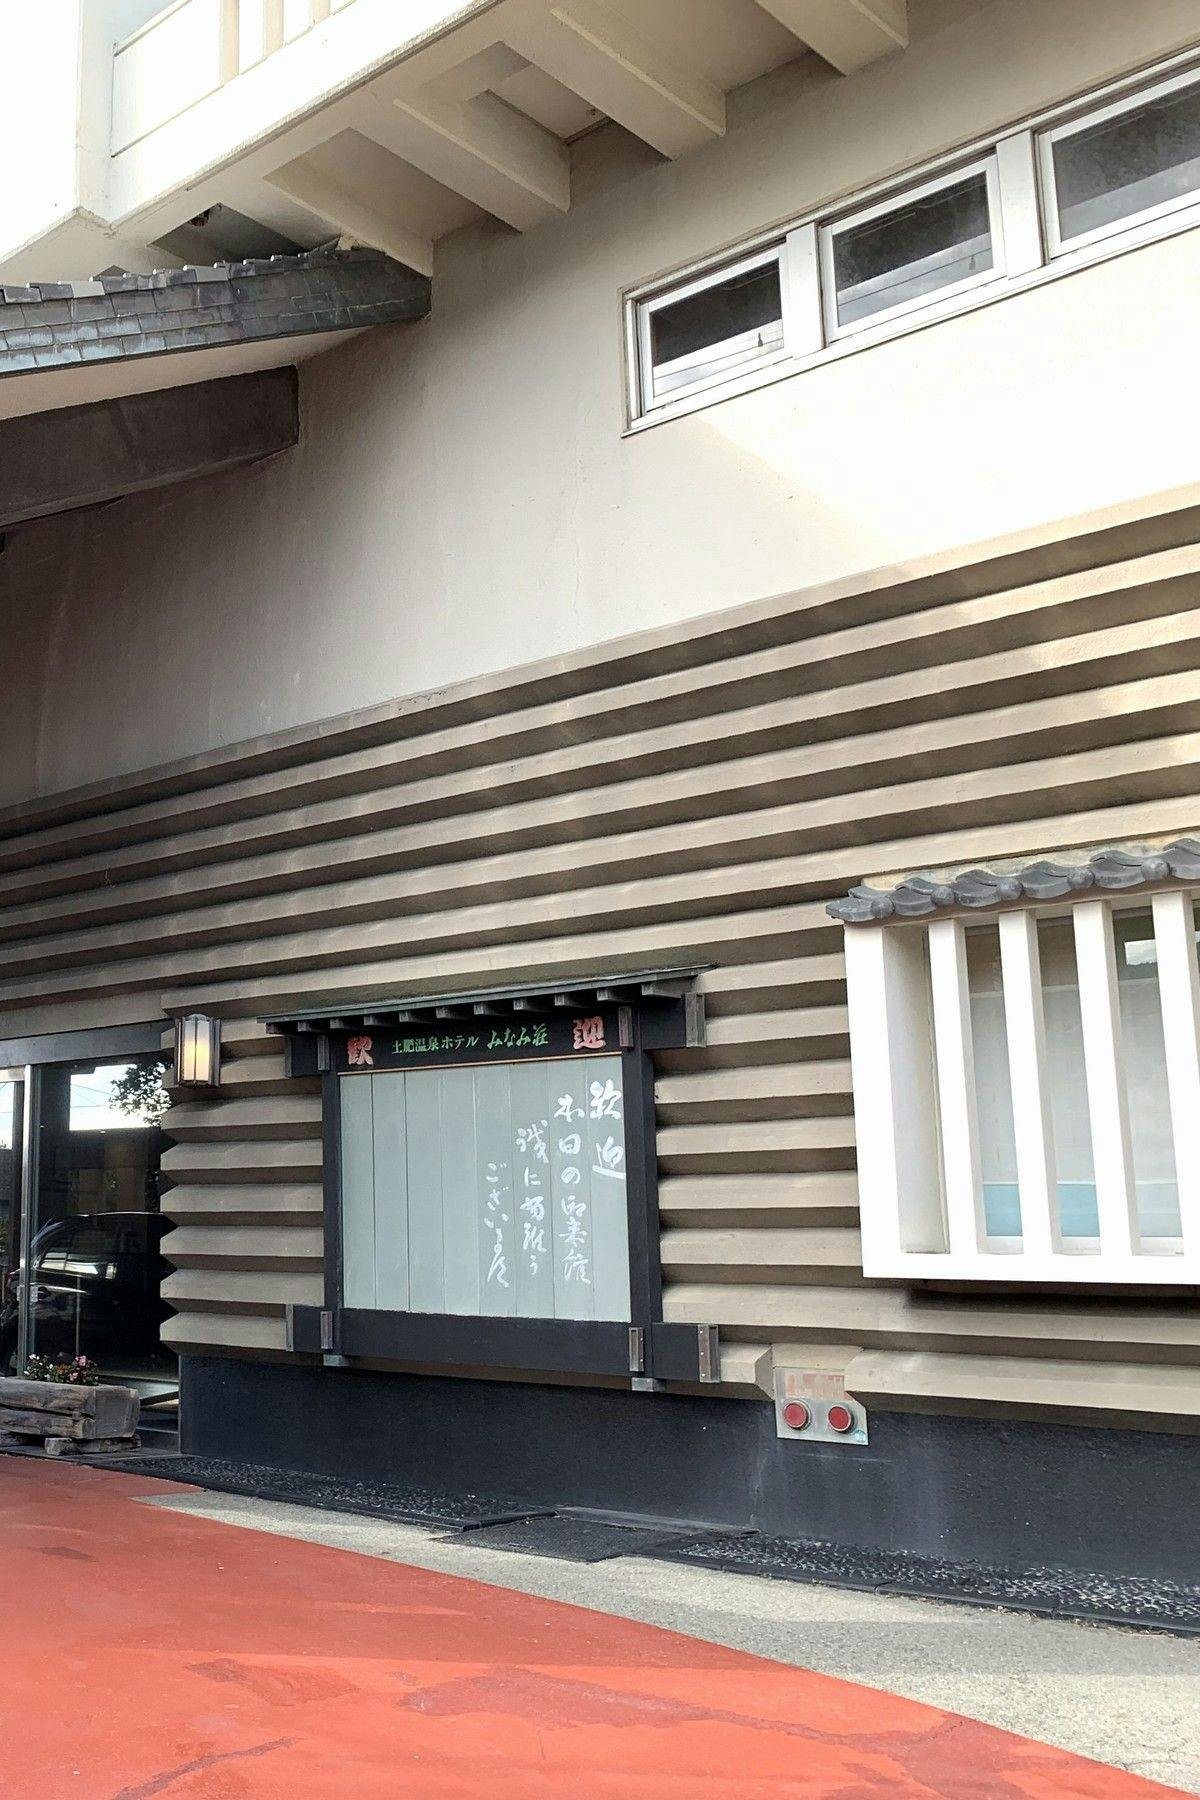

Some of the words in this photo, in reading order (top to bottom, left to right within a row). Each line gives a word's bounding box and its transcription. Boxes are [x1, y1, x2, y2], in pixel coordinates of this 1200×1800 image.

[391, 1035, 479, 1054] 土肥温泉ホテル
[486, 1023, 549, 1050] みなみ荘
[572, 1015, 606, 1050] 迎
